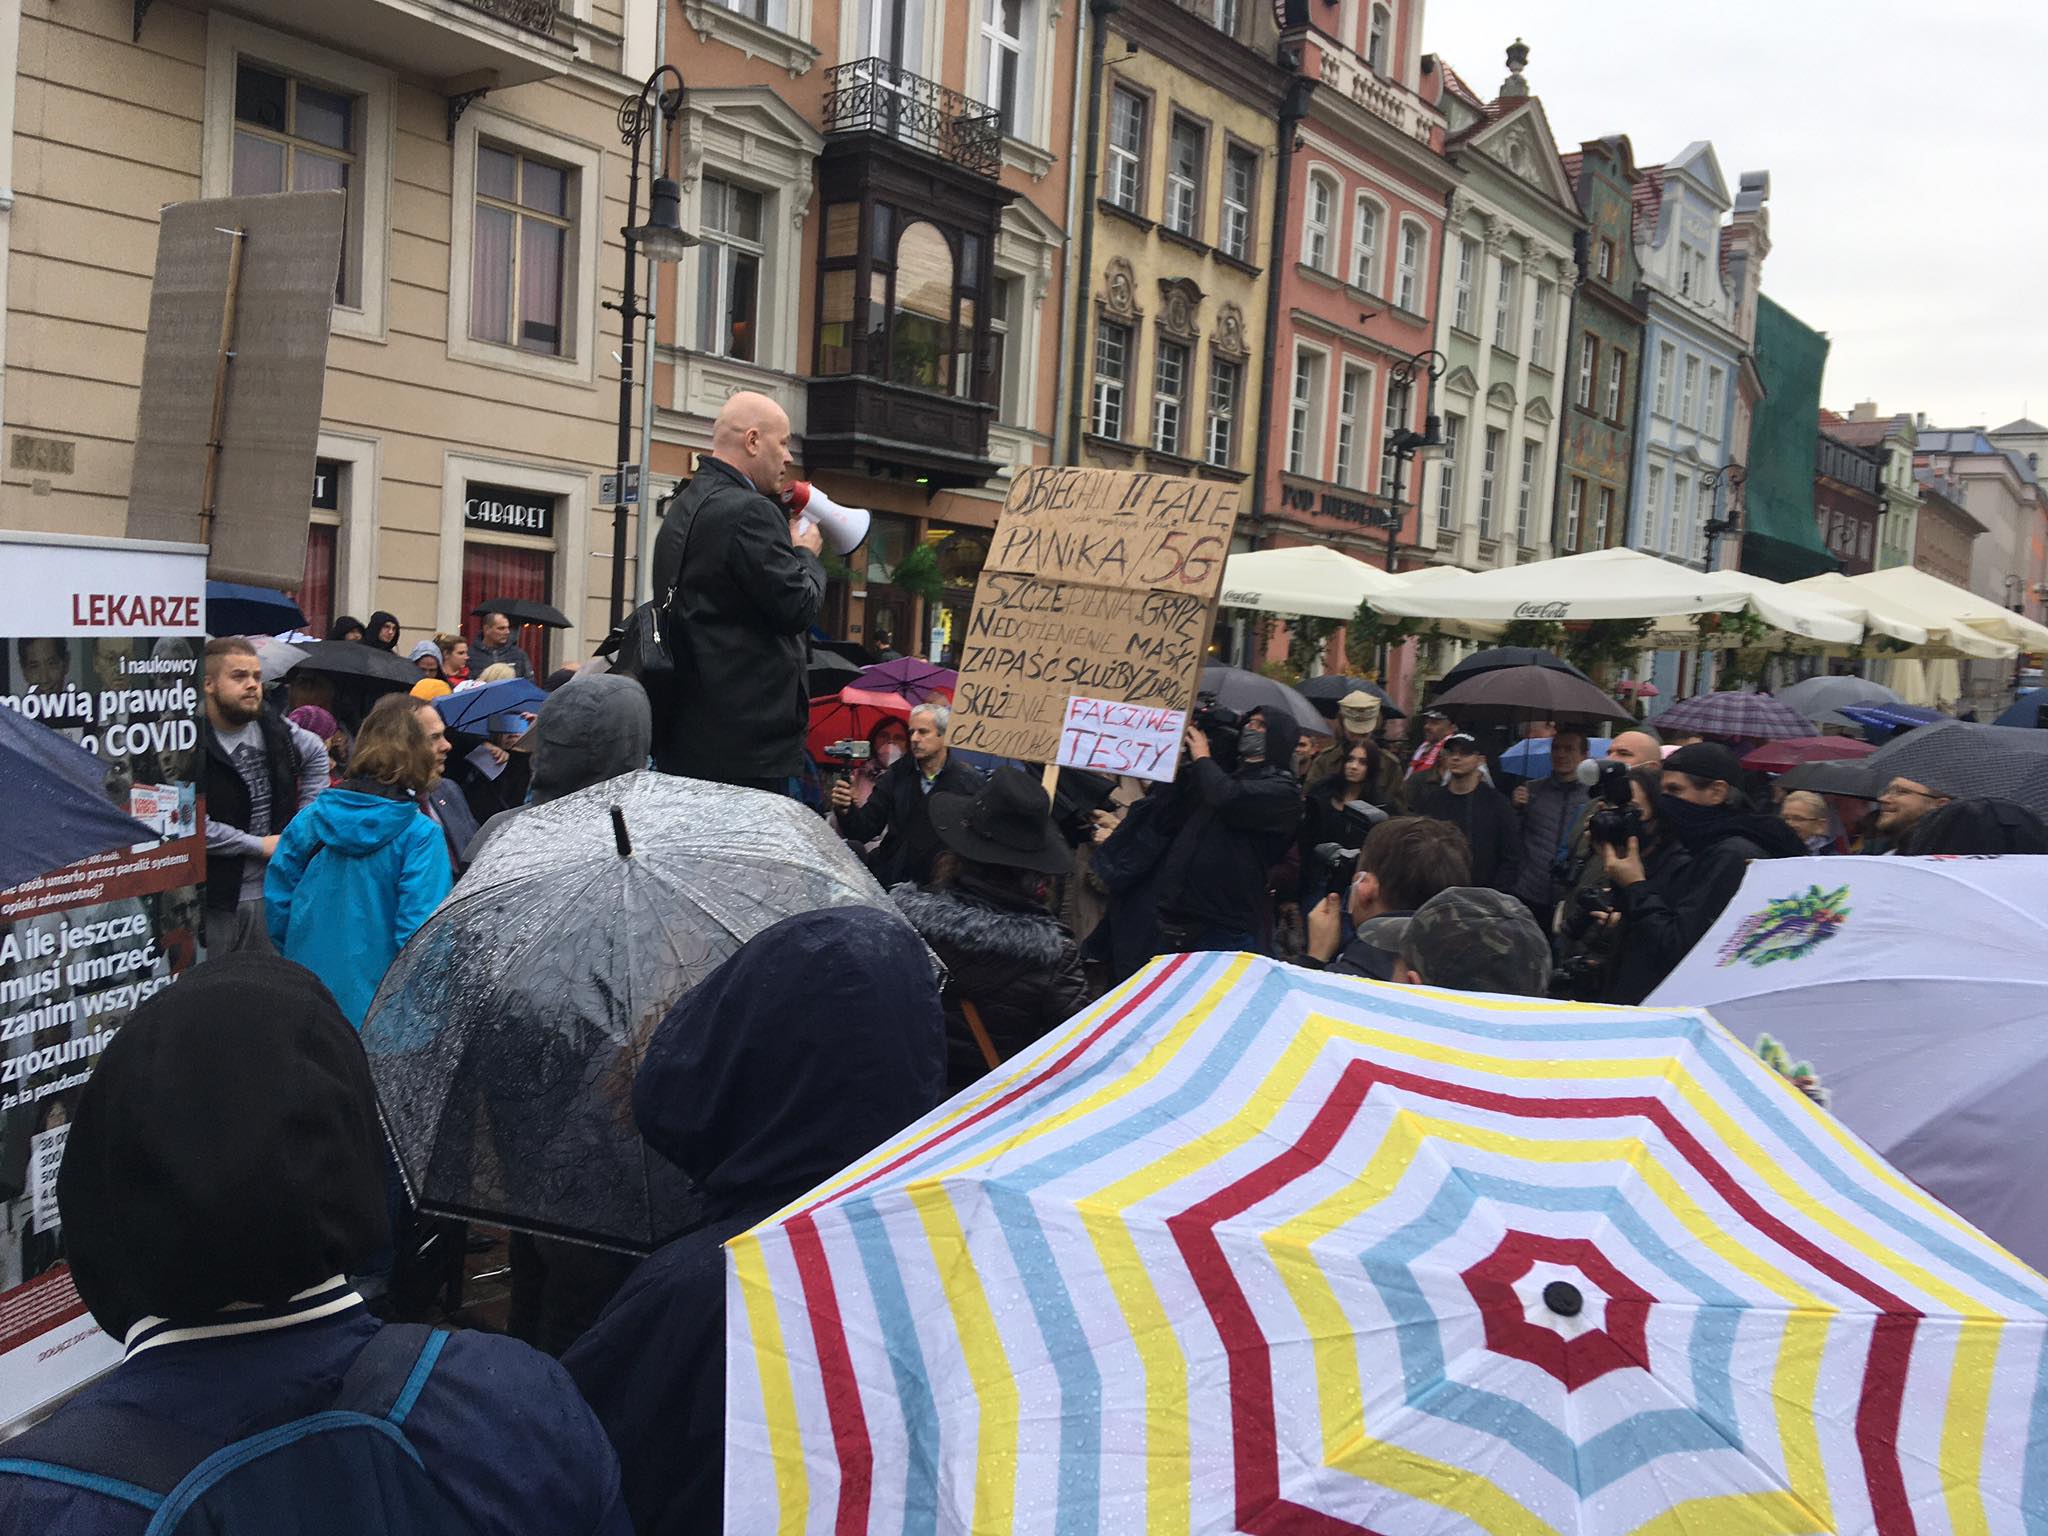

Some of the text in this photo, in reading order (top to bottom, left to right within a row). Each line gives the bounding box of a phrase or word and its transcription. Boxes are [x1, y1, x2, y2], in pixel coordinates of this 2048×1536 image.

[465, 498, 546, 529] CABARET
[73, 593, 200, 627] LEKARZE
[119, 655, 198, 676] i naukowcy
[962, 646, 1062, 682] ZAPAŚĆ
[1061, 657, 1145, 692] SŁUŻBY
[100, 679, 197, 722] prawdę
[953, 683, 1053, 724] SKAŻENIE
[105, 719, 197, 757] COVID
[1066, 727, 1173, 772] TESTY
[19, 875, 45, 893] osób
[46, 869, 85, 887] umarło
[87, 866, 115, 882] przez
[116, 858, 151, 878] paraliż
[151, 853, 190, 870] systemu
[1, 883, 104, 917] opieki zdrowotnej?
[0, 913, 148, 967] A ile jeszcze
[0, 960, 61, 1005] musi
[0, 998, 77, 1042] zanim
[0, 1093, 18, 1112] że
[18, 1089, 34, 1105] ta
